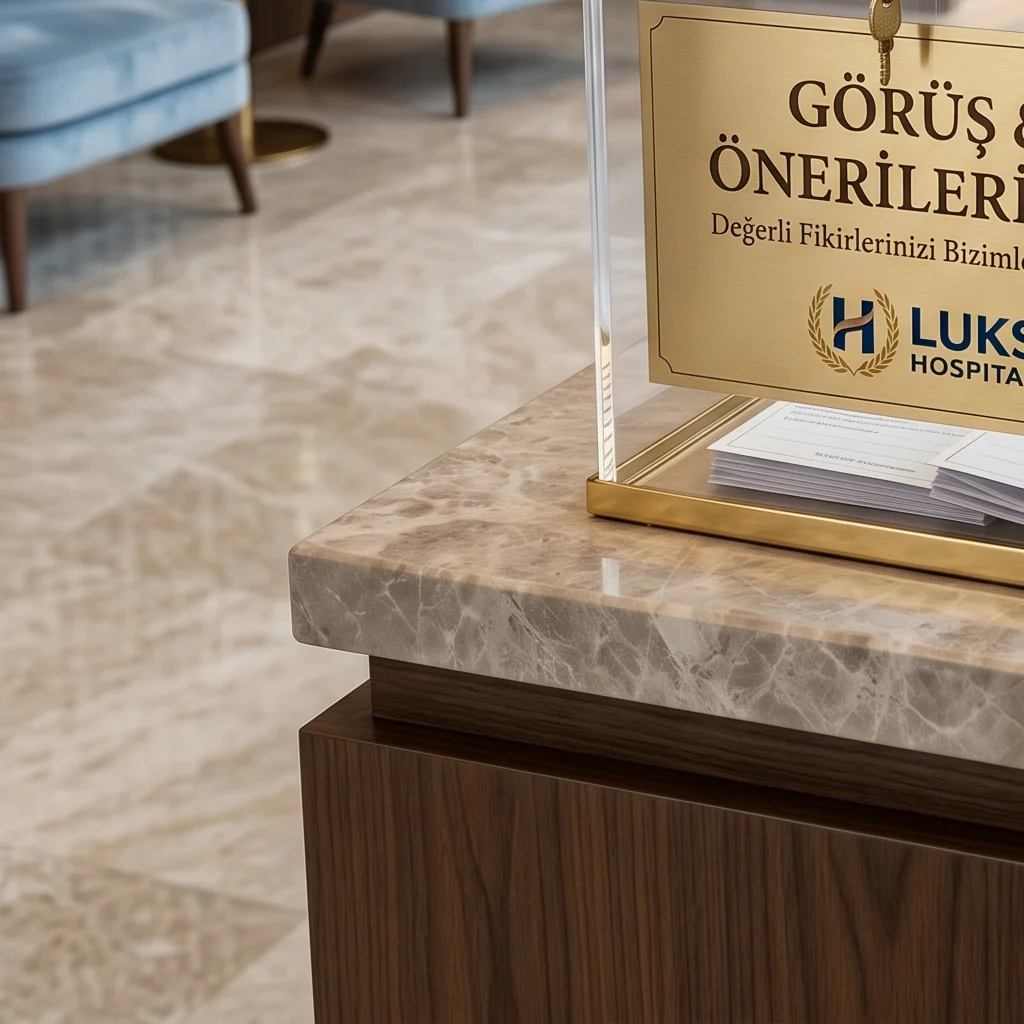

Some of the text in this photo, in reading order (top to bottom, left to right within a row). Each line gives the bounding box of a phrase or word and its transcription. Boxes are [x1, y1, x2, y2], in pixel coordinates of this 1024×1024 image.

[788, 72, 997, 160] GÖRÜŞ
[711, 212, 793, 248] Değerli
[799, 223, 937, 262] Fikirlerinizi
